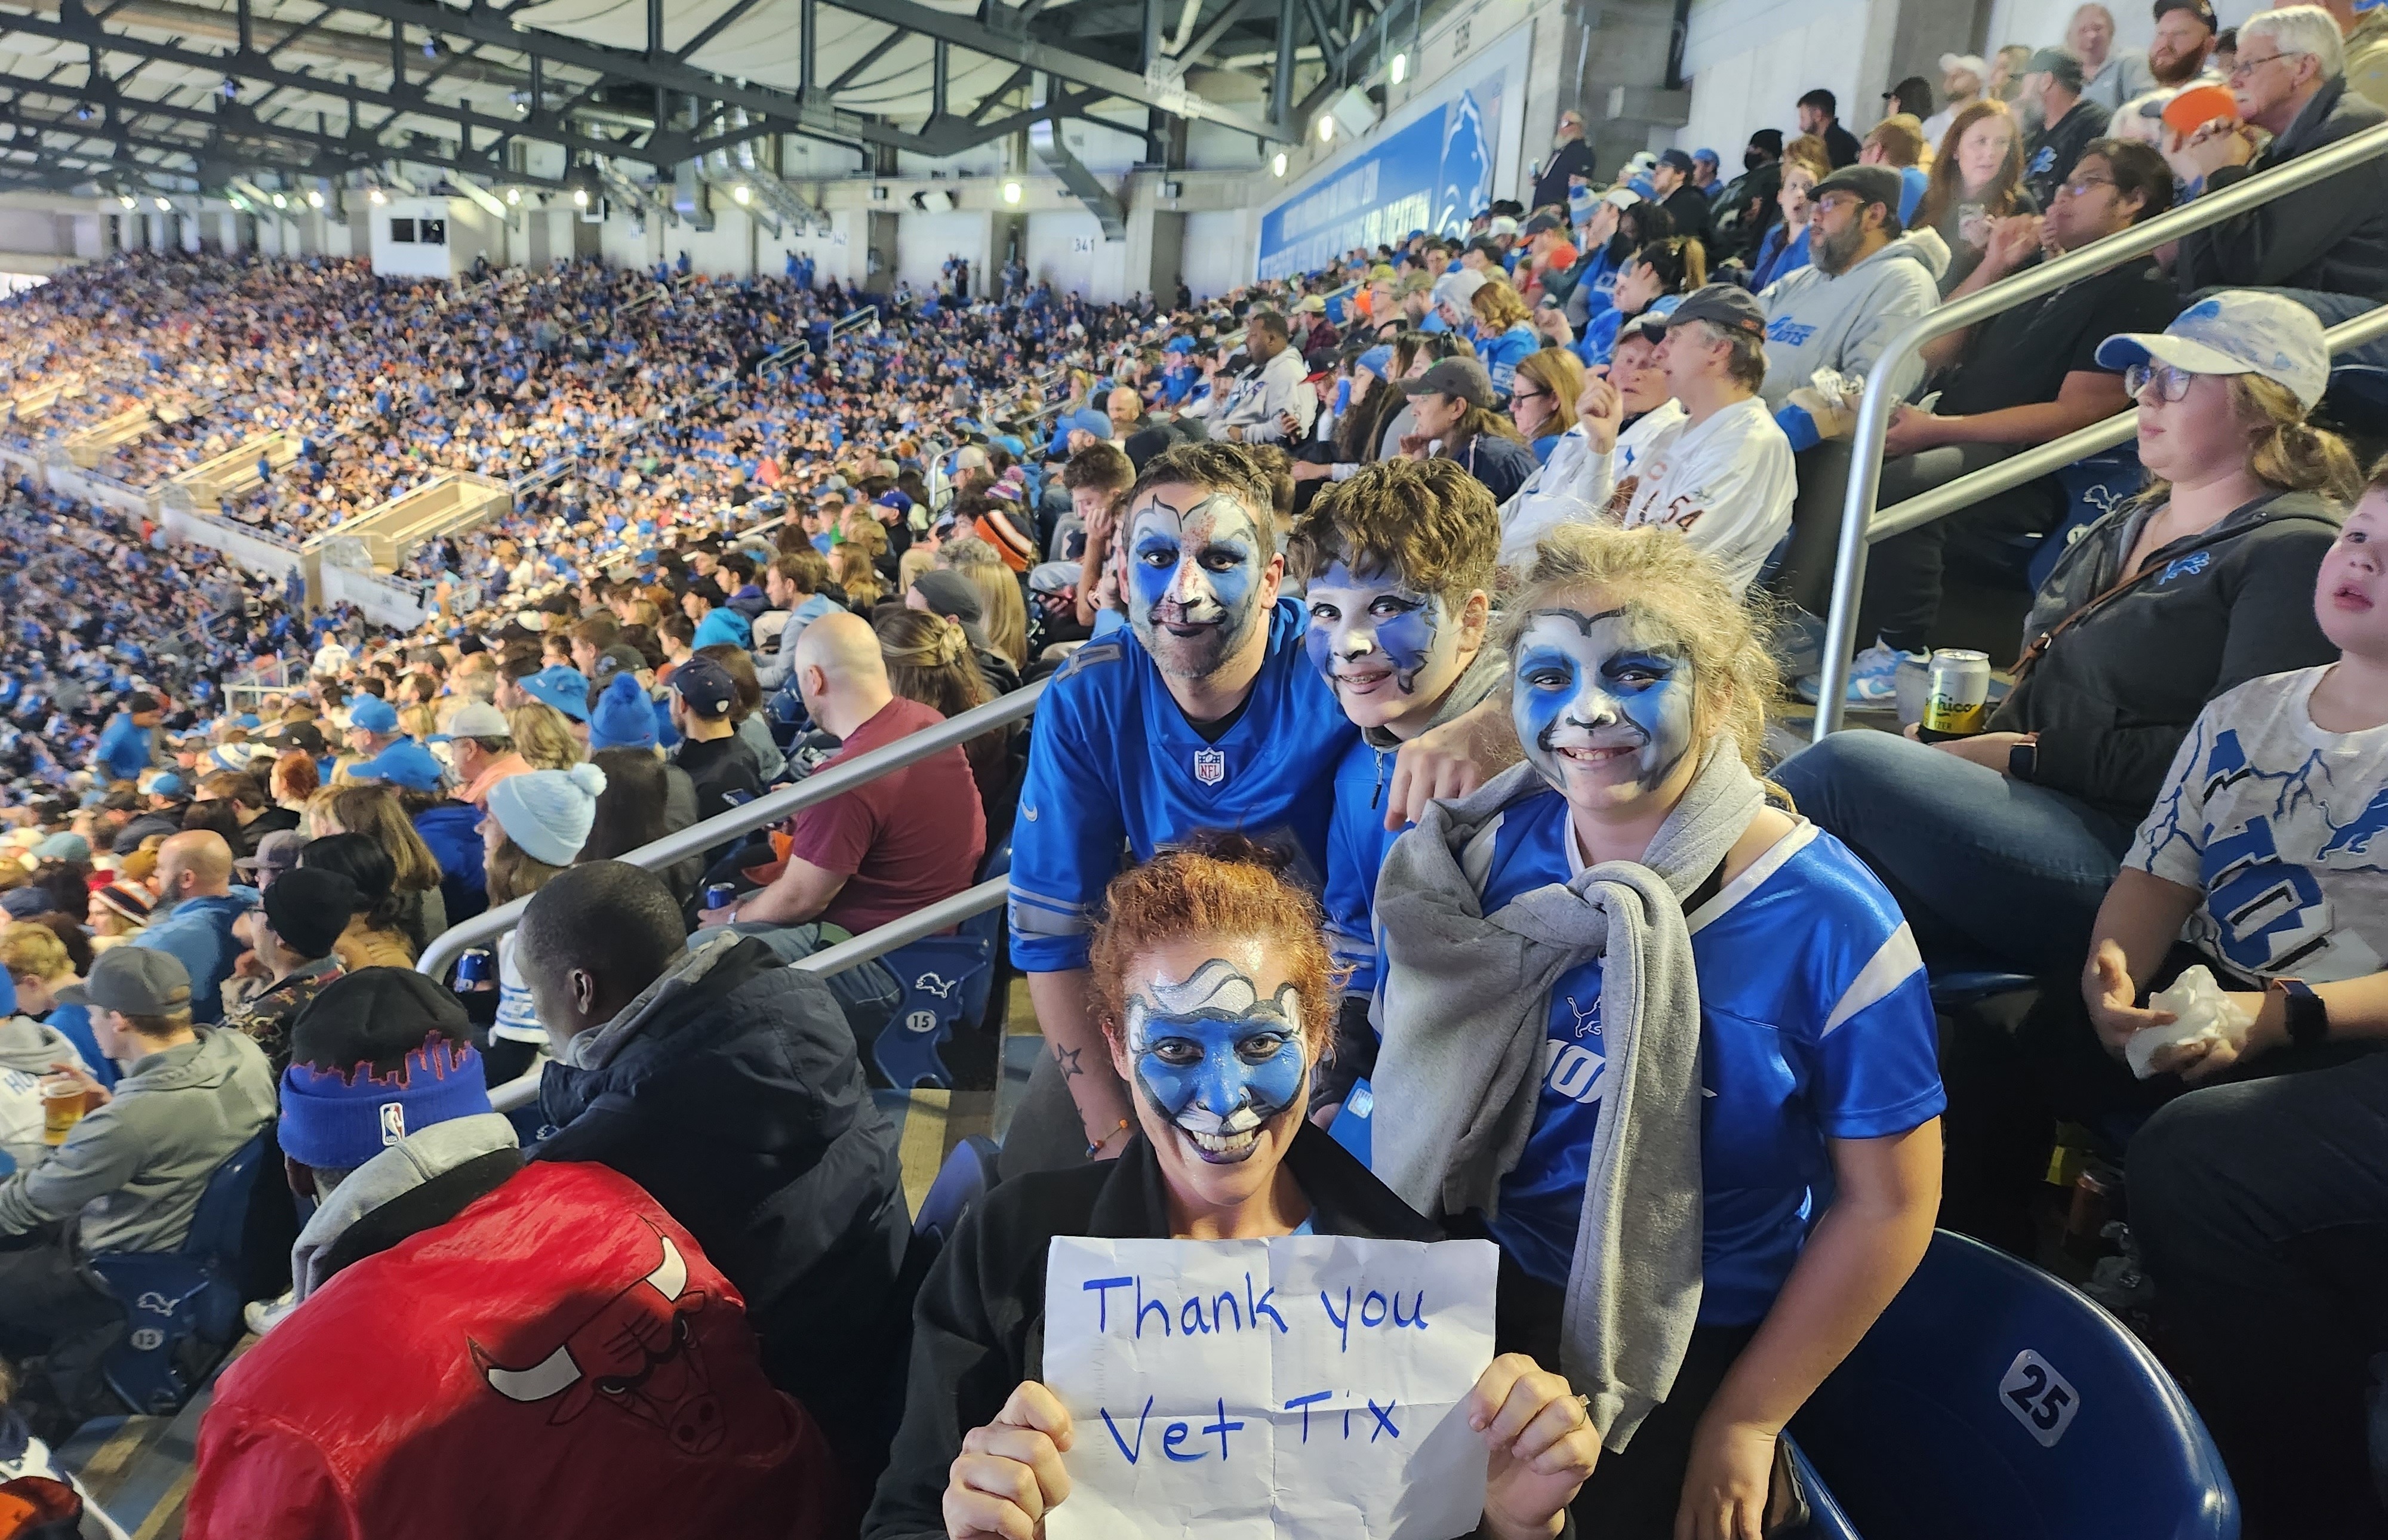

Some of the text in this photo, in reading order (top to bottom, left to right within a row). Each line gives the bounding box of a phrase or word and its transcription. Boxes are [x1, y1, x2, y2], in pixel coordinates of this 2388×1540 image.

[1075, 238, 1095, 252] 341
[1201, 765, 1219, 778] NFL
[913, 1015, 930, 1027] 15
[1083, 1274, 1429, 1353] Thank you
[139, 1333, 156, 1345] 13
[2007, 1364, 2071, 1430] 25
[1100, 1394, 1244, 1465] Vet
[1284, 1390, 1400, 1444] Tix
